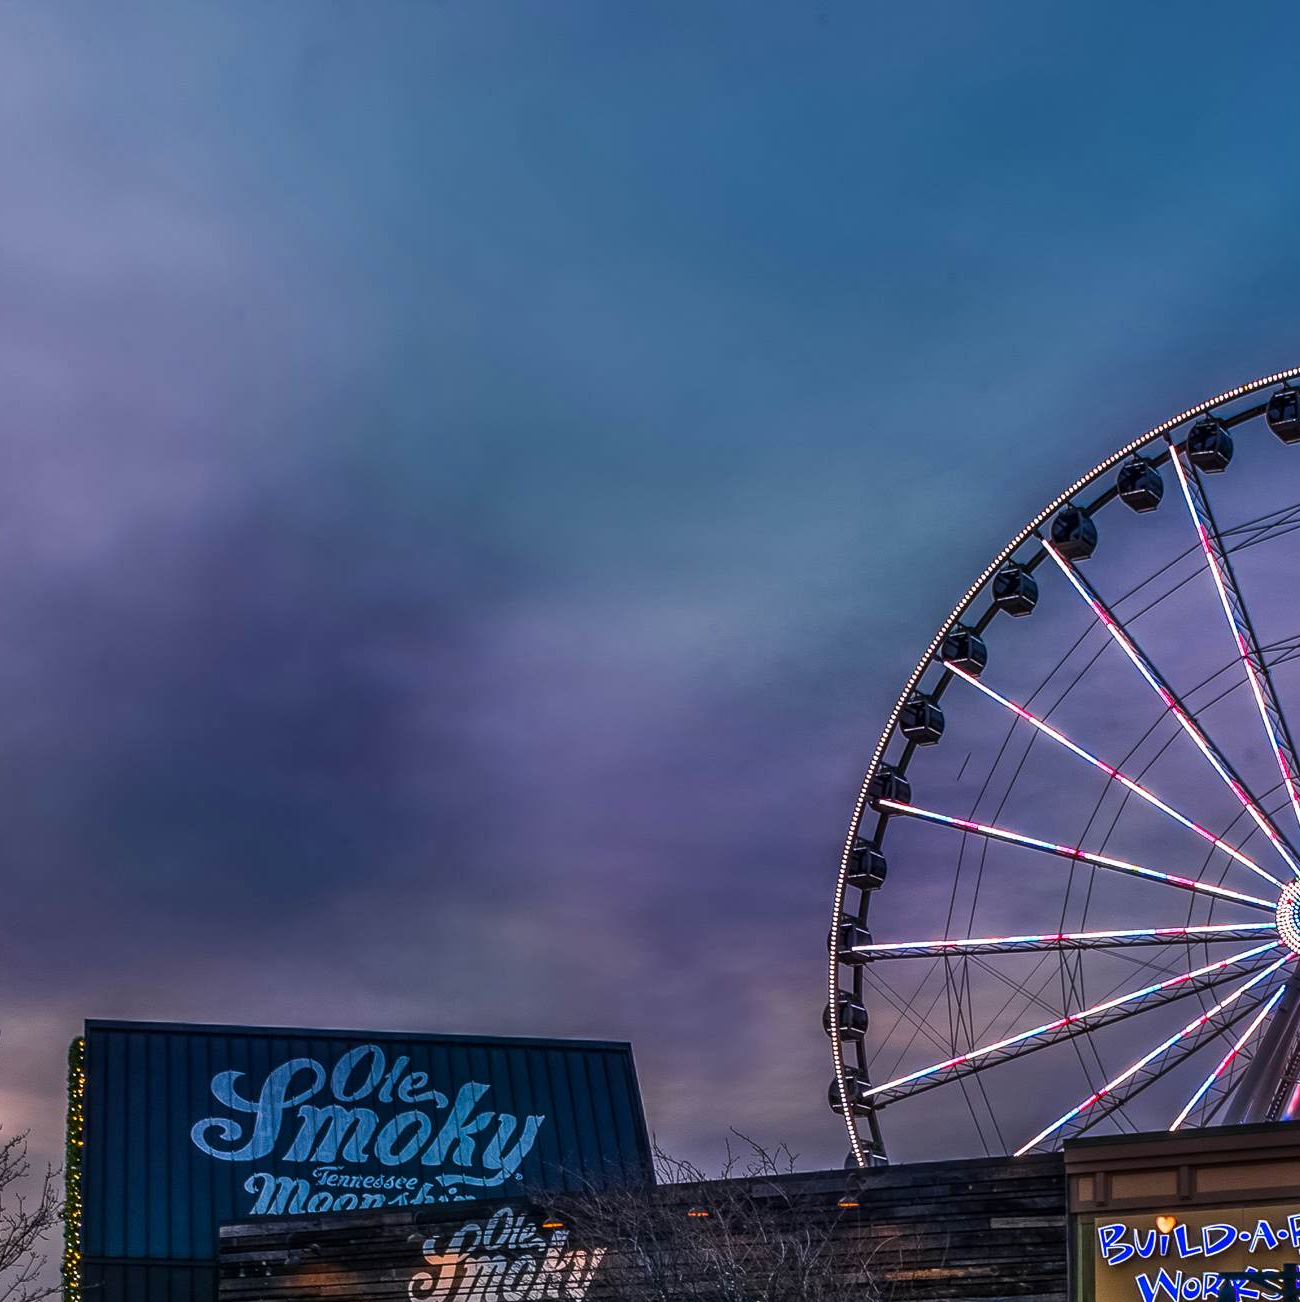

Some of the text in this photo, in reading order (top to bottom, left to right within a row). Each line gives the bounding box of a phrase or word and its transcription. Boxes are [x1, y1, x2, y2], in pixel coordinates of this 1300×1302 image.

[330, 1043, 449, 1110] Ole
[190, 1057, 546, 1188] Smoky
[243, 1172, 477, 1216] Moonsh
[312, 1165, 419, 1190] Tennessee
[484, 1207, 547, 1251] Ole
